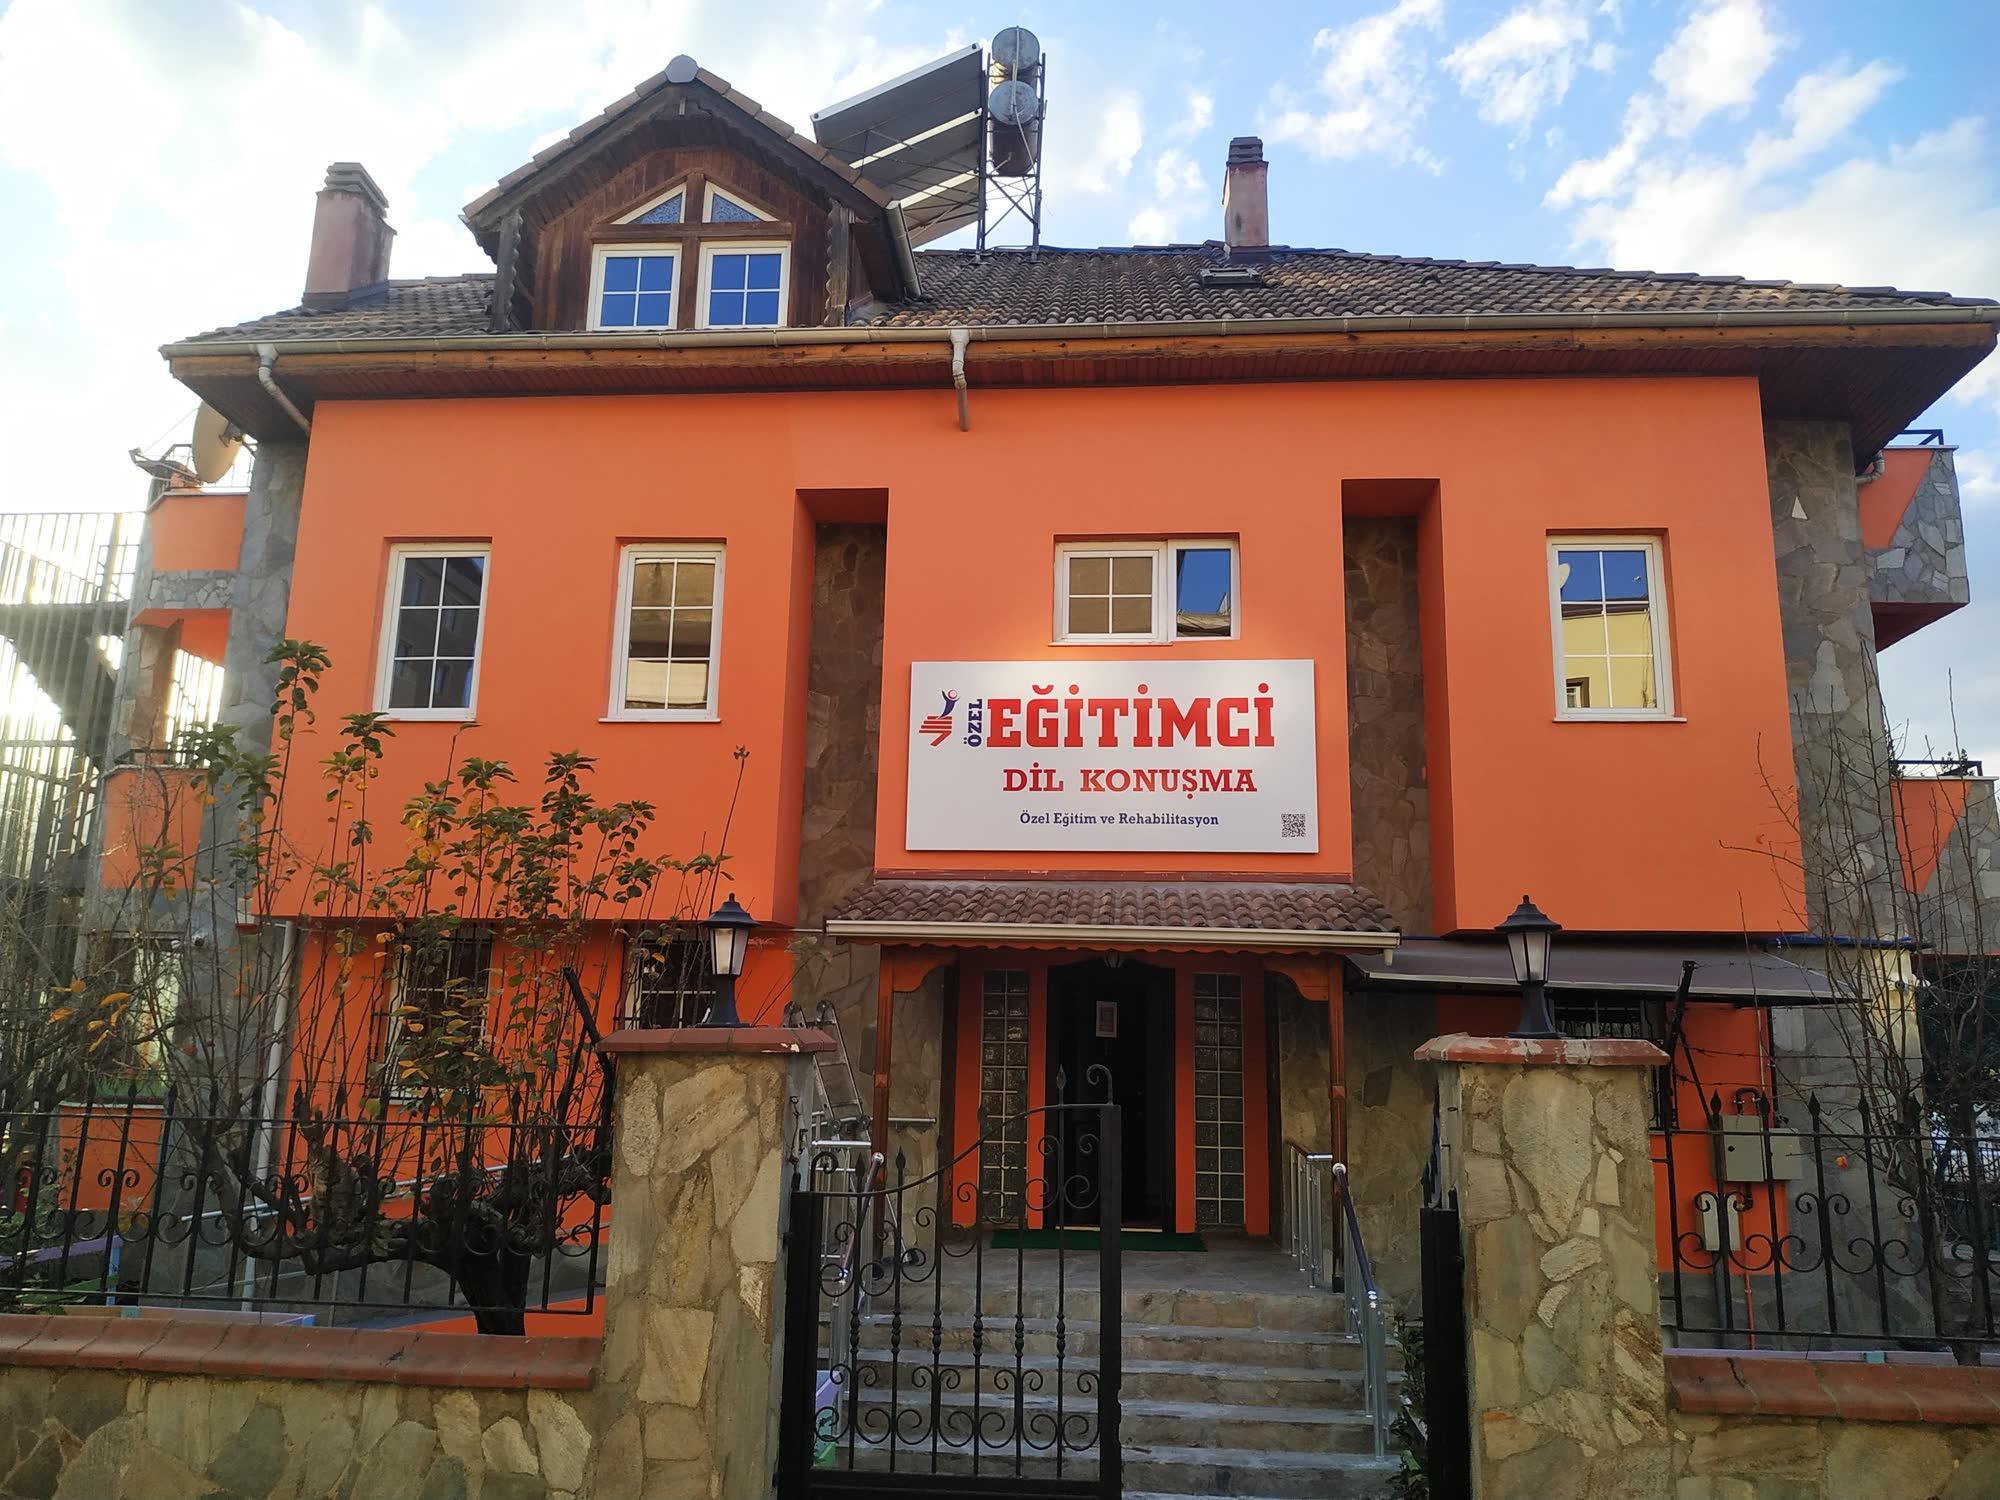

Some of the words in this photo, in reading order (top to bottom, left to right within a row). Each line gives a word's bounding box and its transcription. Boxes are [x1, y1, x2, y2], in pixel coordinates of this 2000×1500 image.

[963, 698, 983, 748] ÖZEL
[986, 682, 1275, 748] EĞİTİMCİ
[1003, 761, 1064, 792] DİL
[1079, 768, 1258, 800] KONUŞMA
[1019, 810, 1050, 824] Özel
[1053, 812, 1097, 827] Eğitim
[1099, 815, 1116, 825] ve
[1118, 812, 1220, 828] Rehabilitasyon
